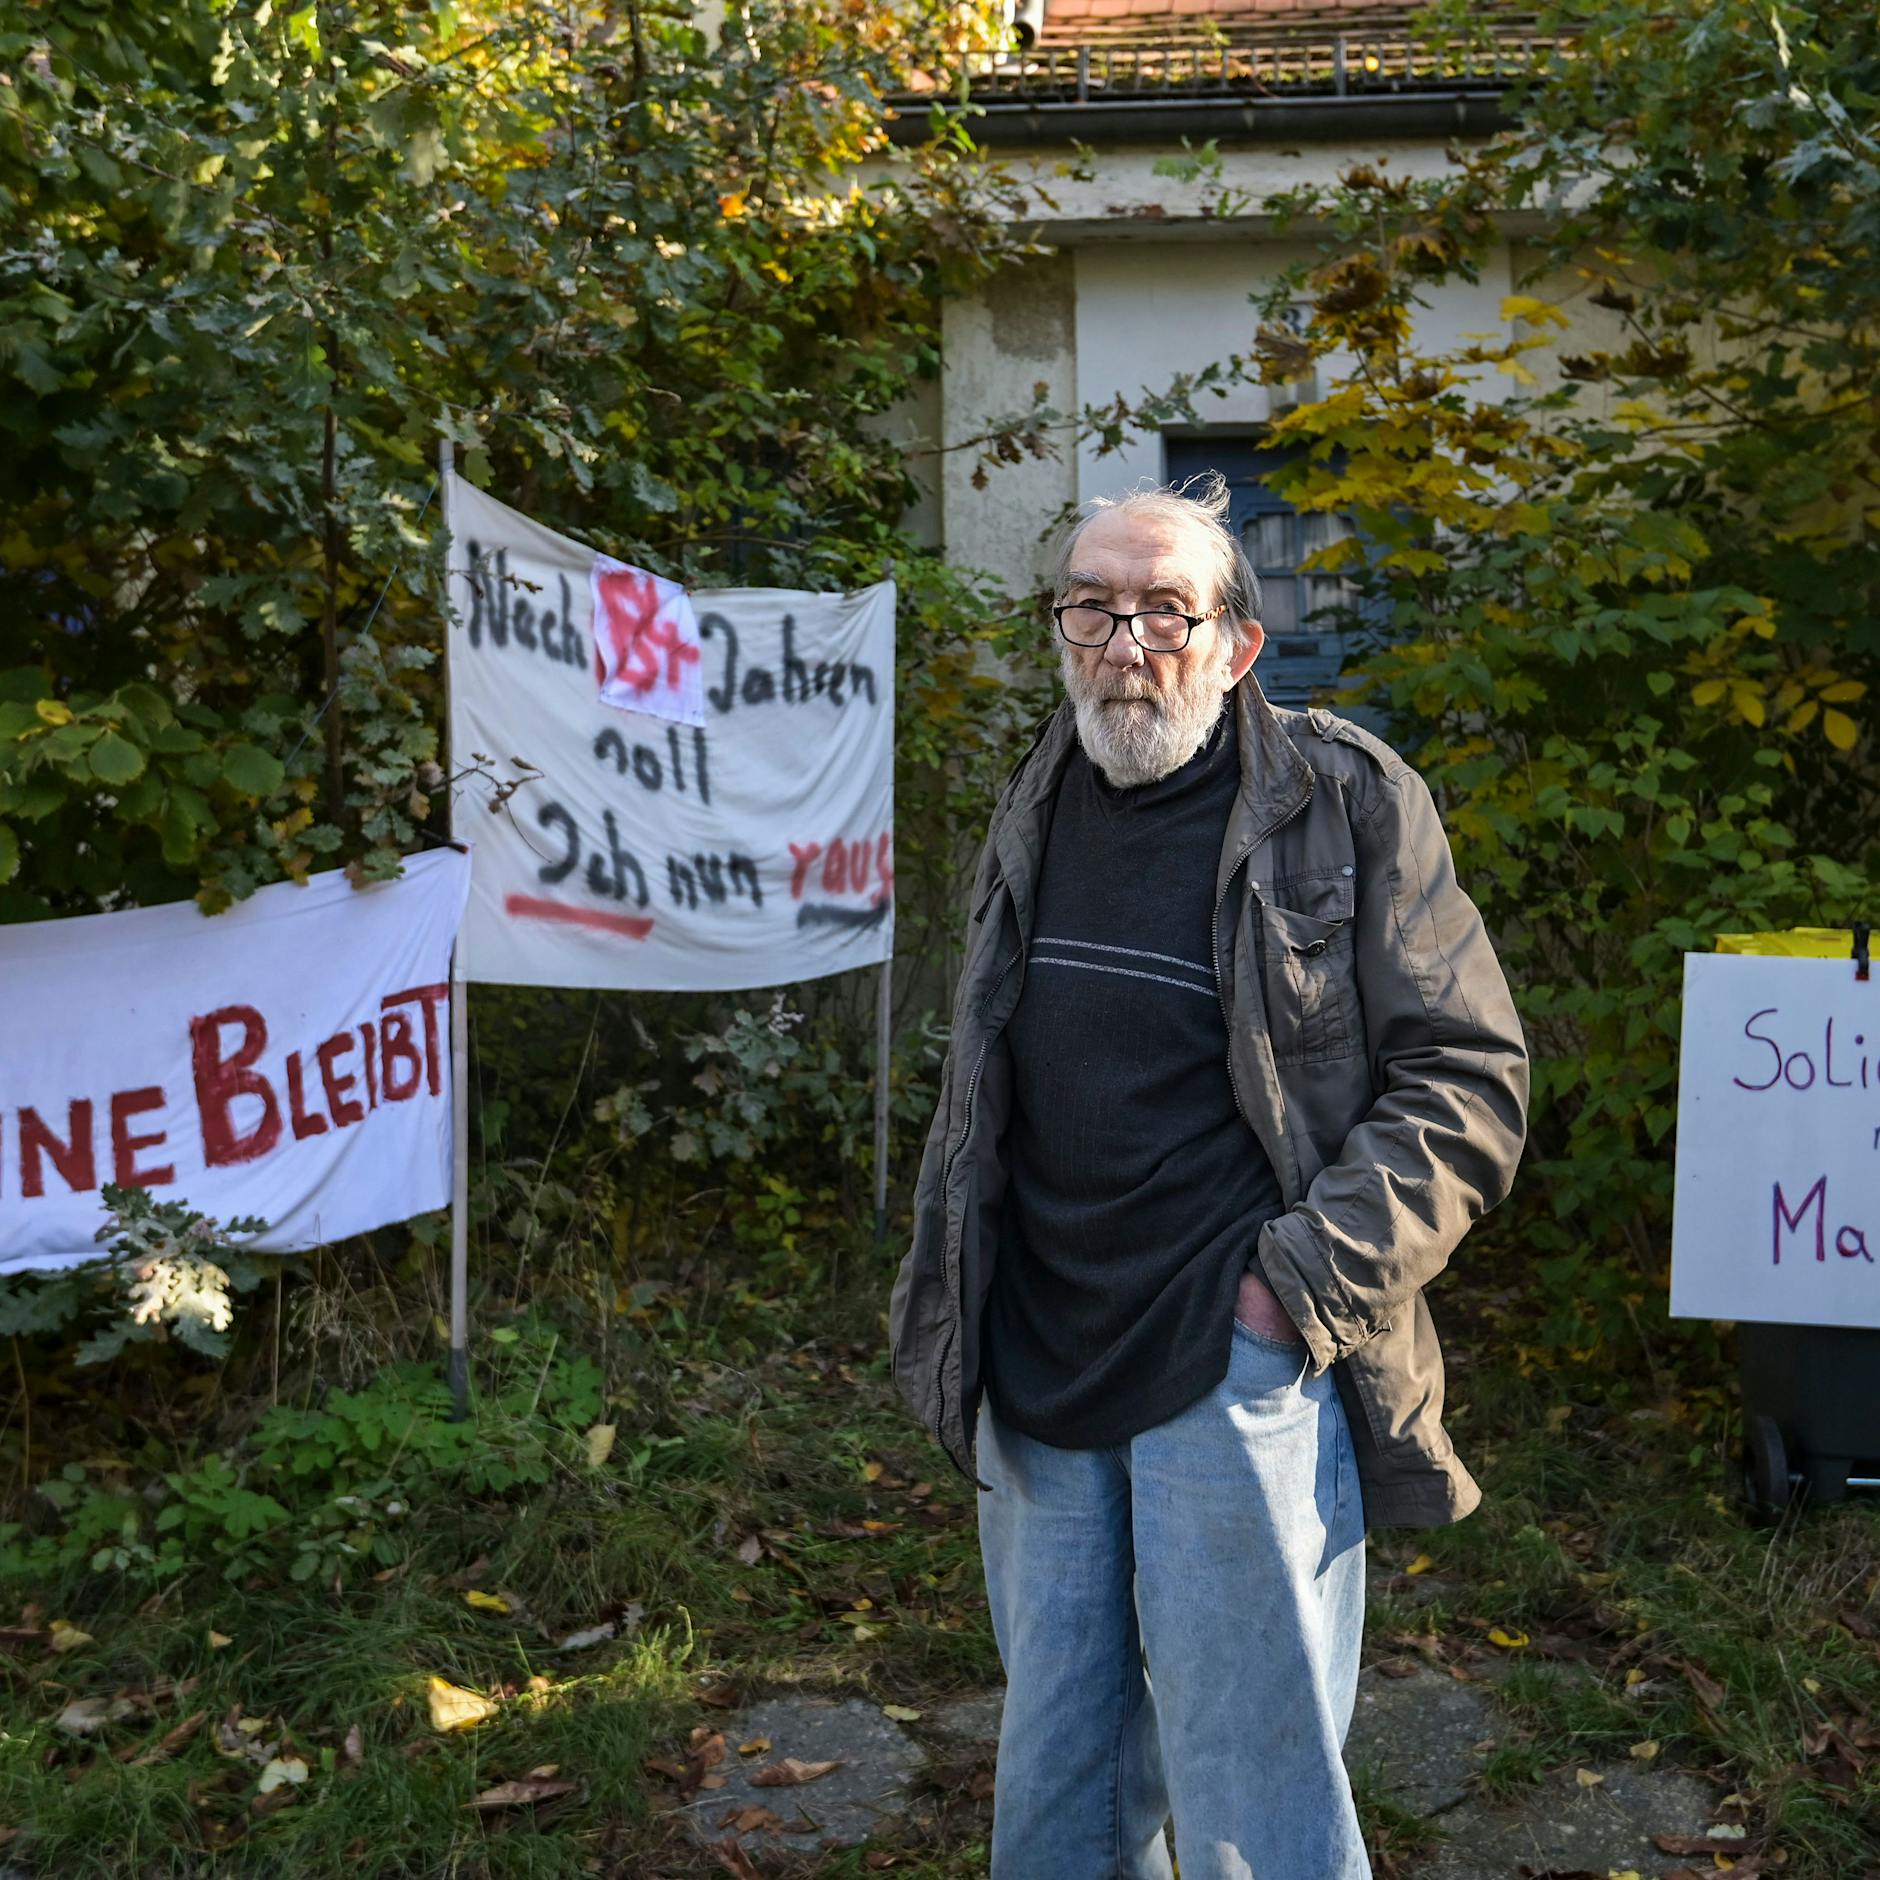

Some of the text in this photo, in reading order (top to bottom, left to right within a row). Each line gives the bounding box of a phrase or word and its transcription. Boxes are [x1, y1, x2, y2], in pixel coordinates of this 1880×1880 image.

[466, 538, 878, 715] Nach 84 Jahren
[666, 852, 763, 910] nun
[0, 982, 450, 1198] NE BLEIBT
